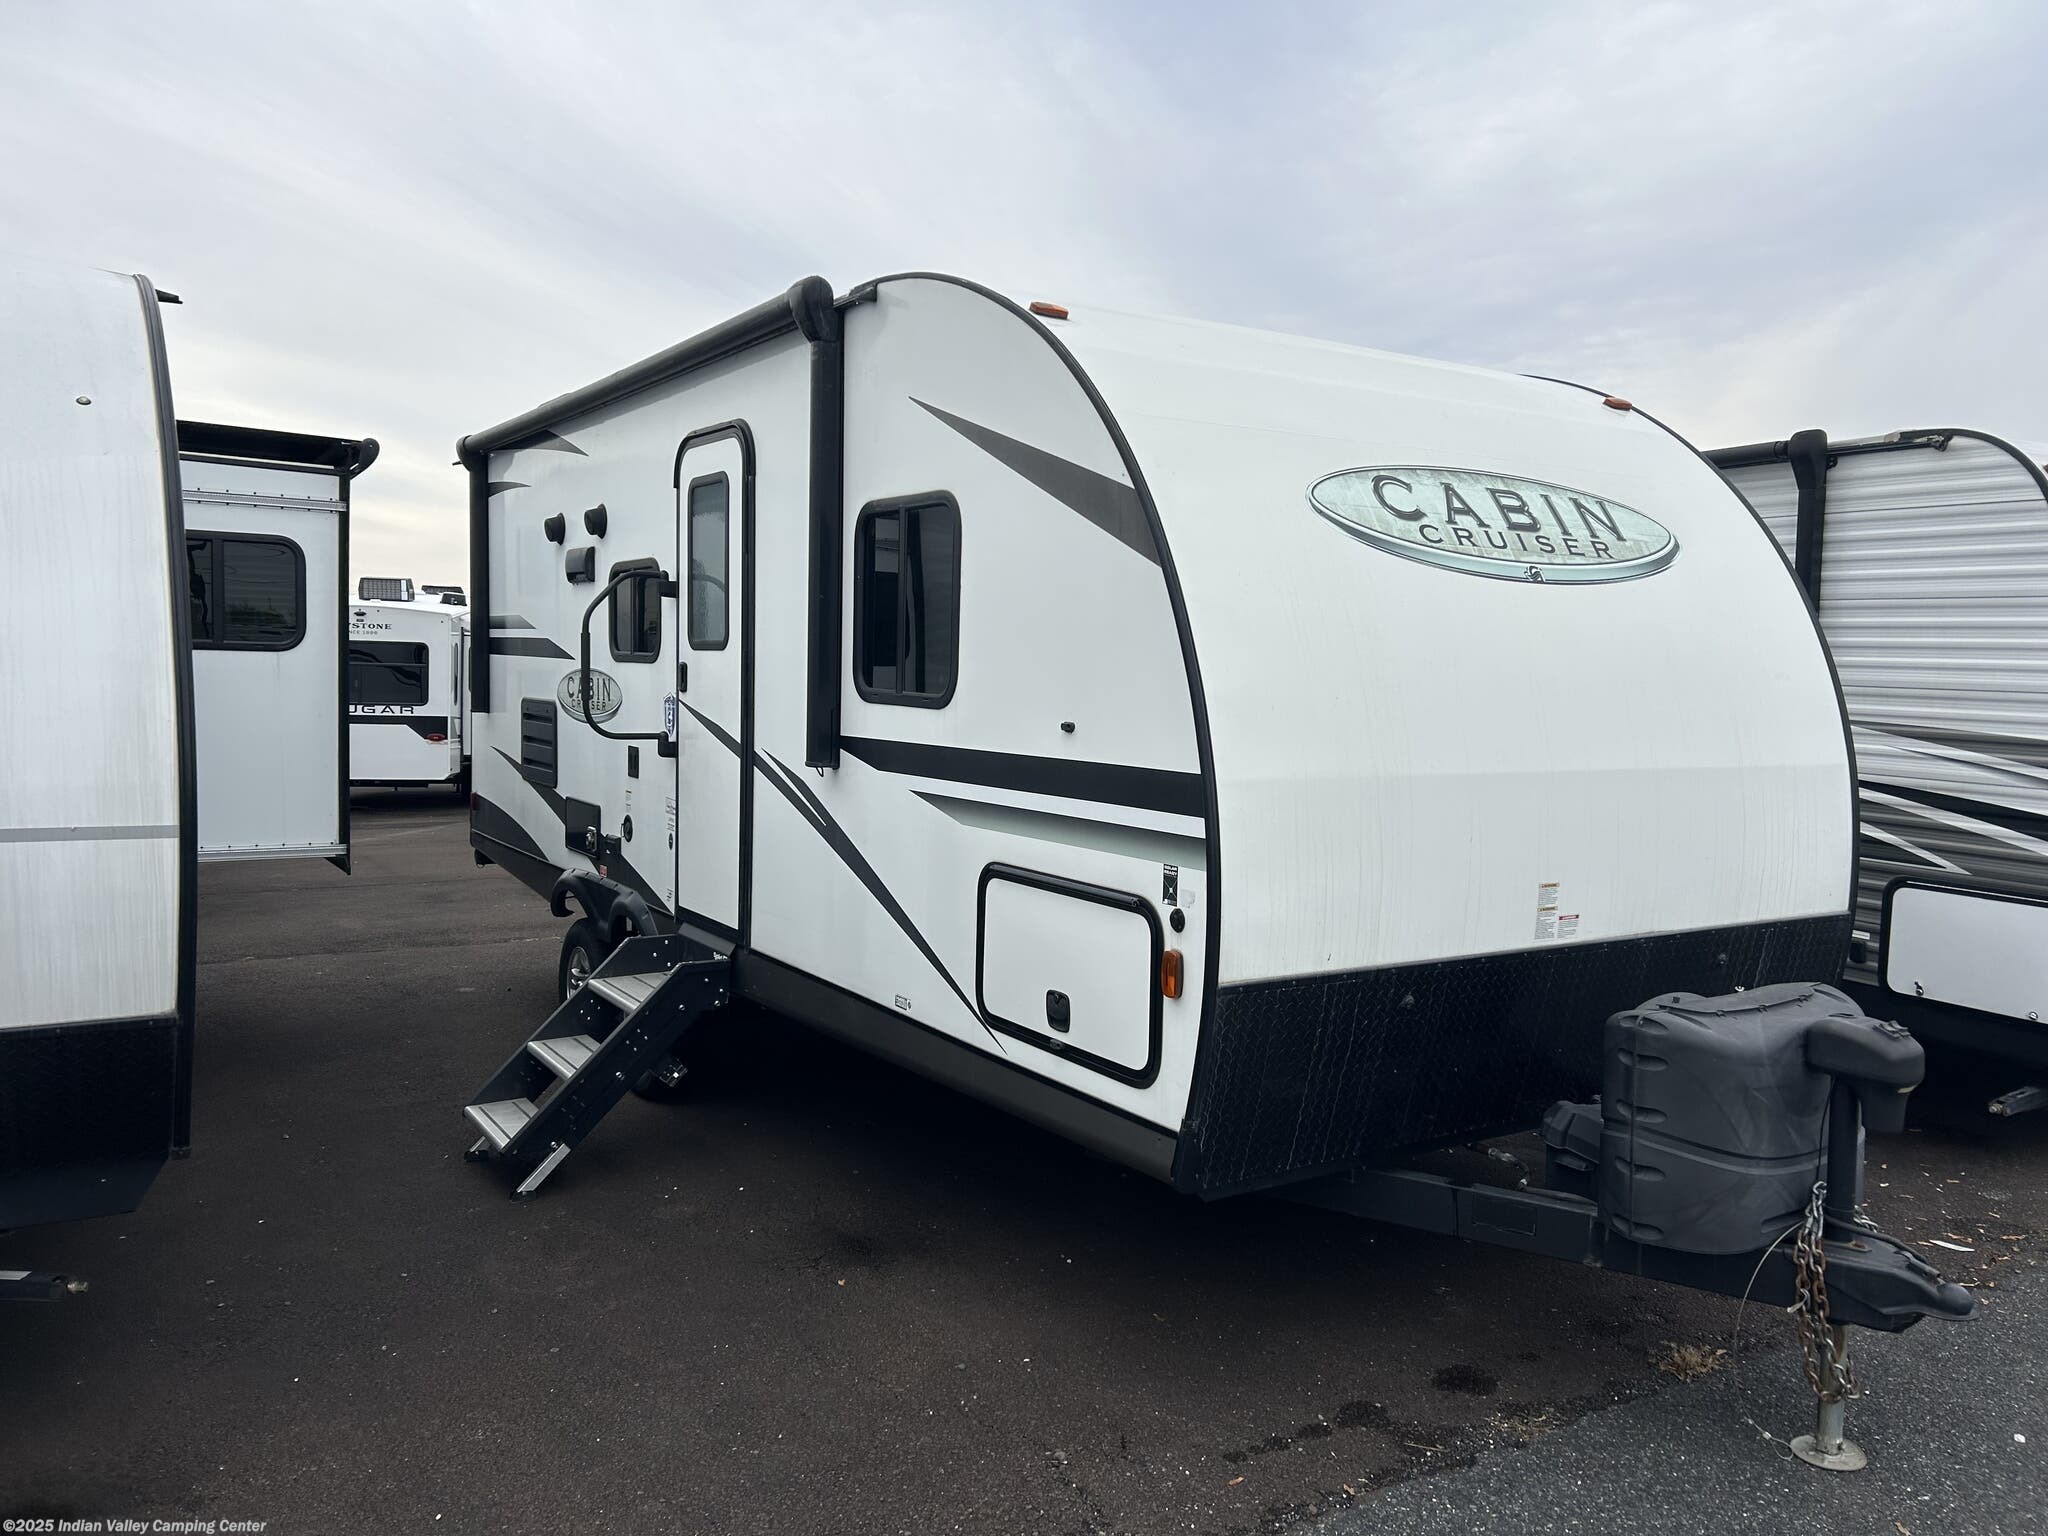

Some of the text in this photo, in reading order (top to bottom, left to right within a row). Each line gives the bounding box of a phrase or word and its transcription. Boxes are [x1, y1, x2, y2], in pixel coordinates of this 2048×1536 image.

[1371, 474, 1626, 542] CABIN
[1419, 524, 1614, 559] CRUISER
[349, 622, 392, 630] STONE
[571, 699, 606, 711] CRSER
